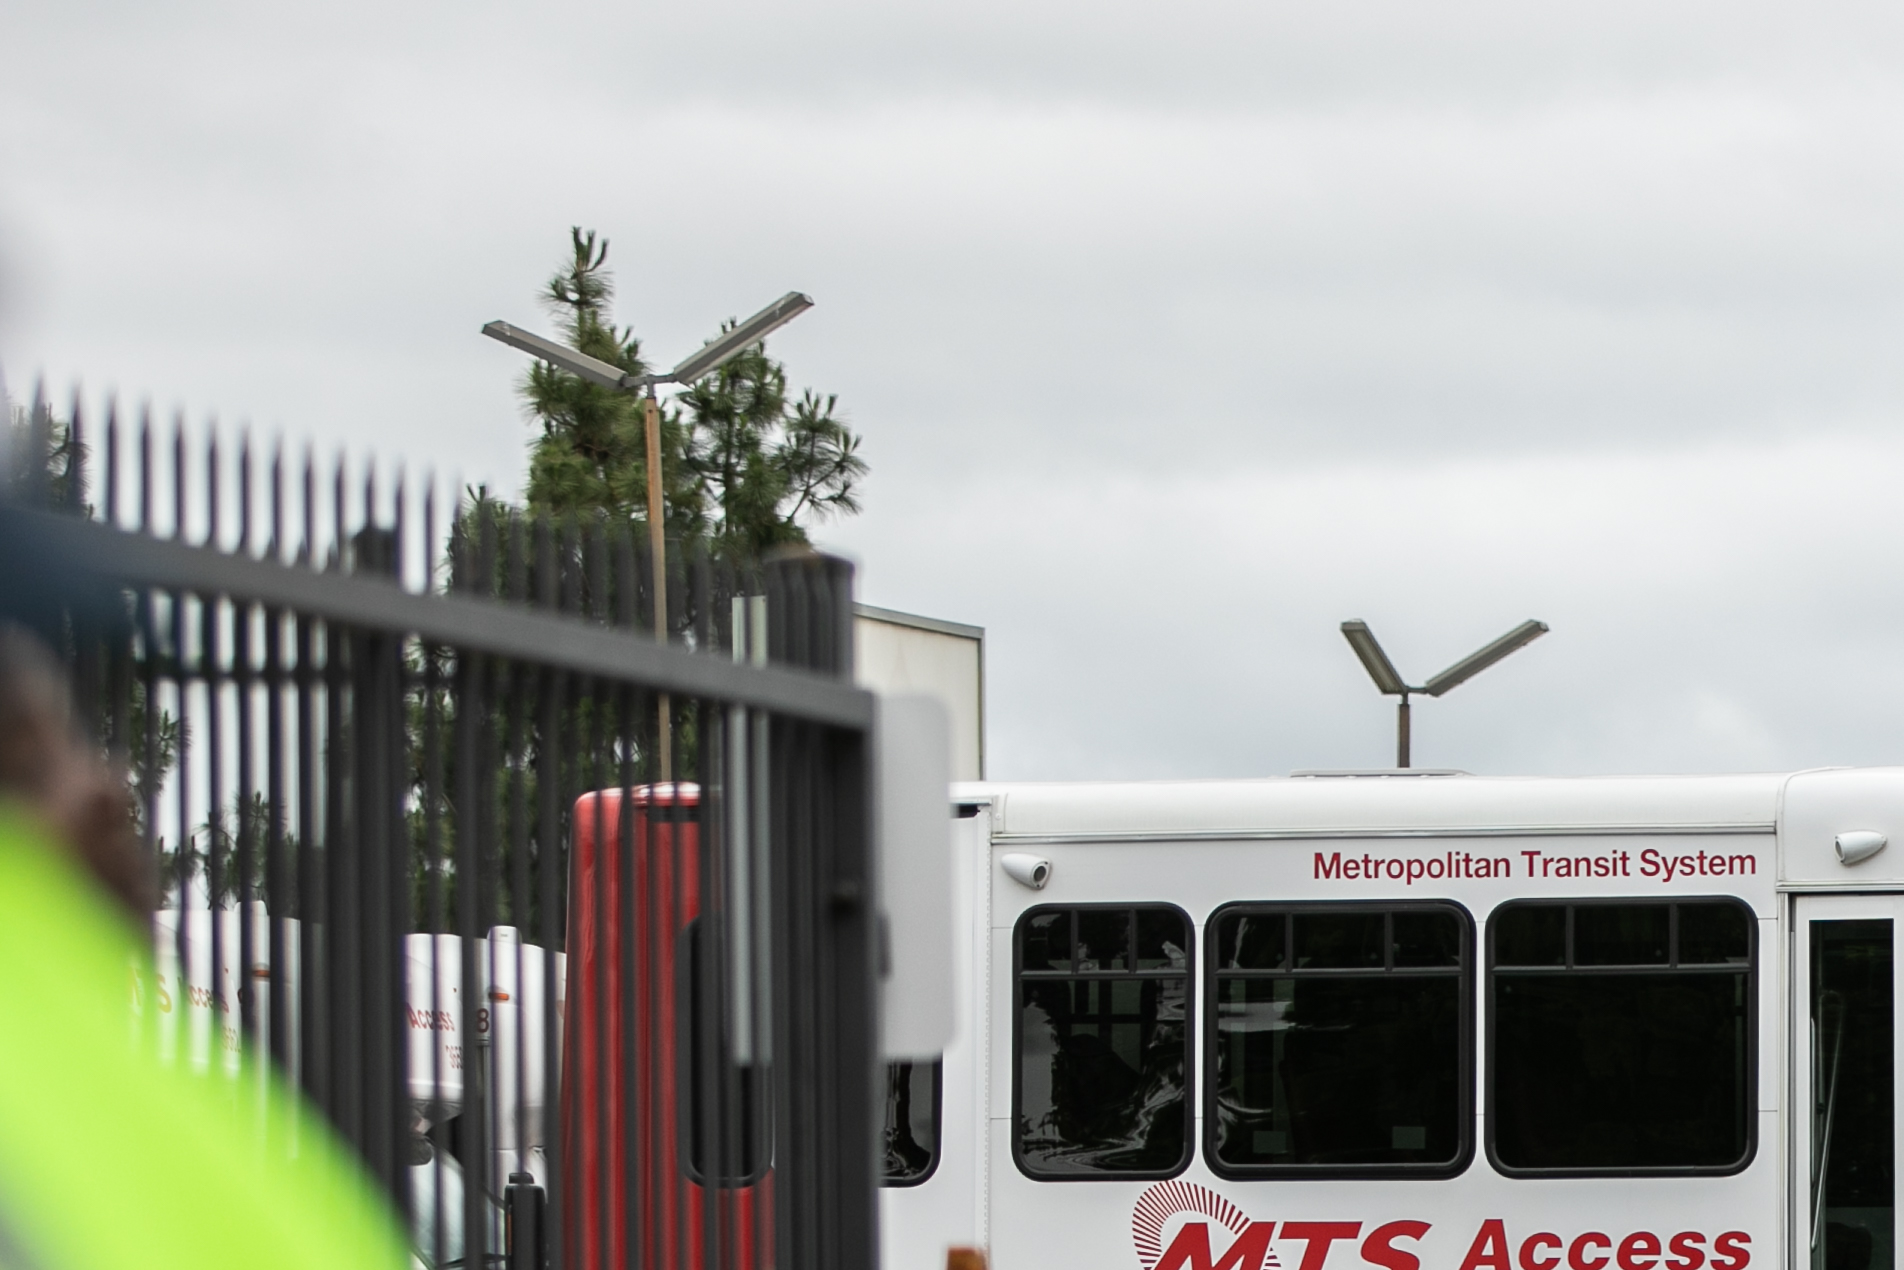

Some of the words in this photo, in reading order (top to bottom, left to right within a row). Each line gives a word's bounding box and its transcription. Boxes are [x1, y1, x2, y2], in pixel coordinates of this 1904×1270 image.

[1312, 851, 1512, 886] Metropolitan
[1521, 850, 1631, 878] Transit
[1638, 849, 1757, 883] System
